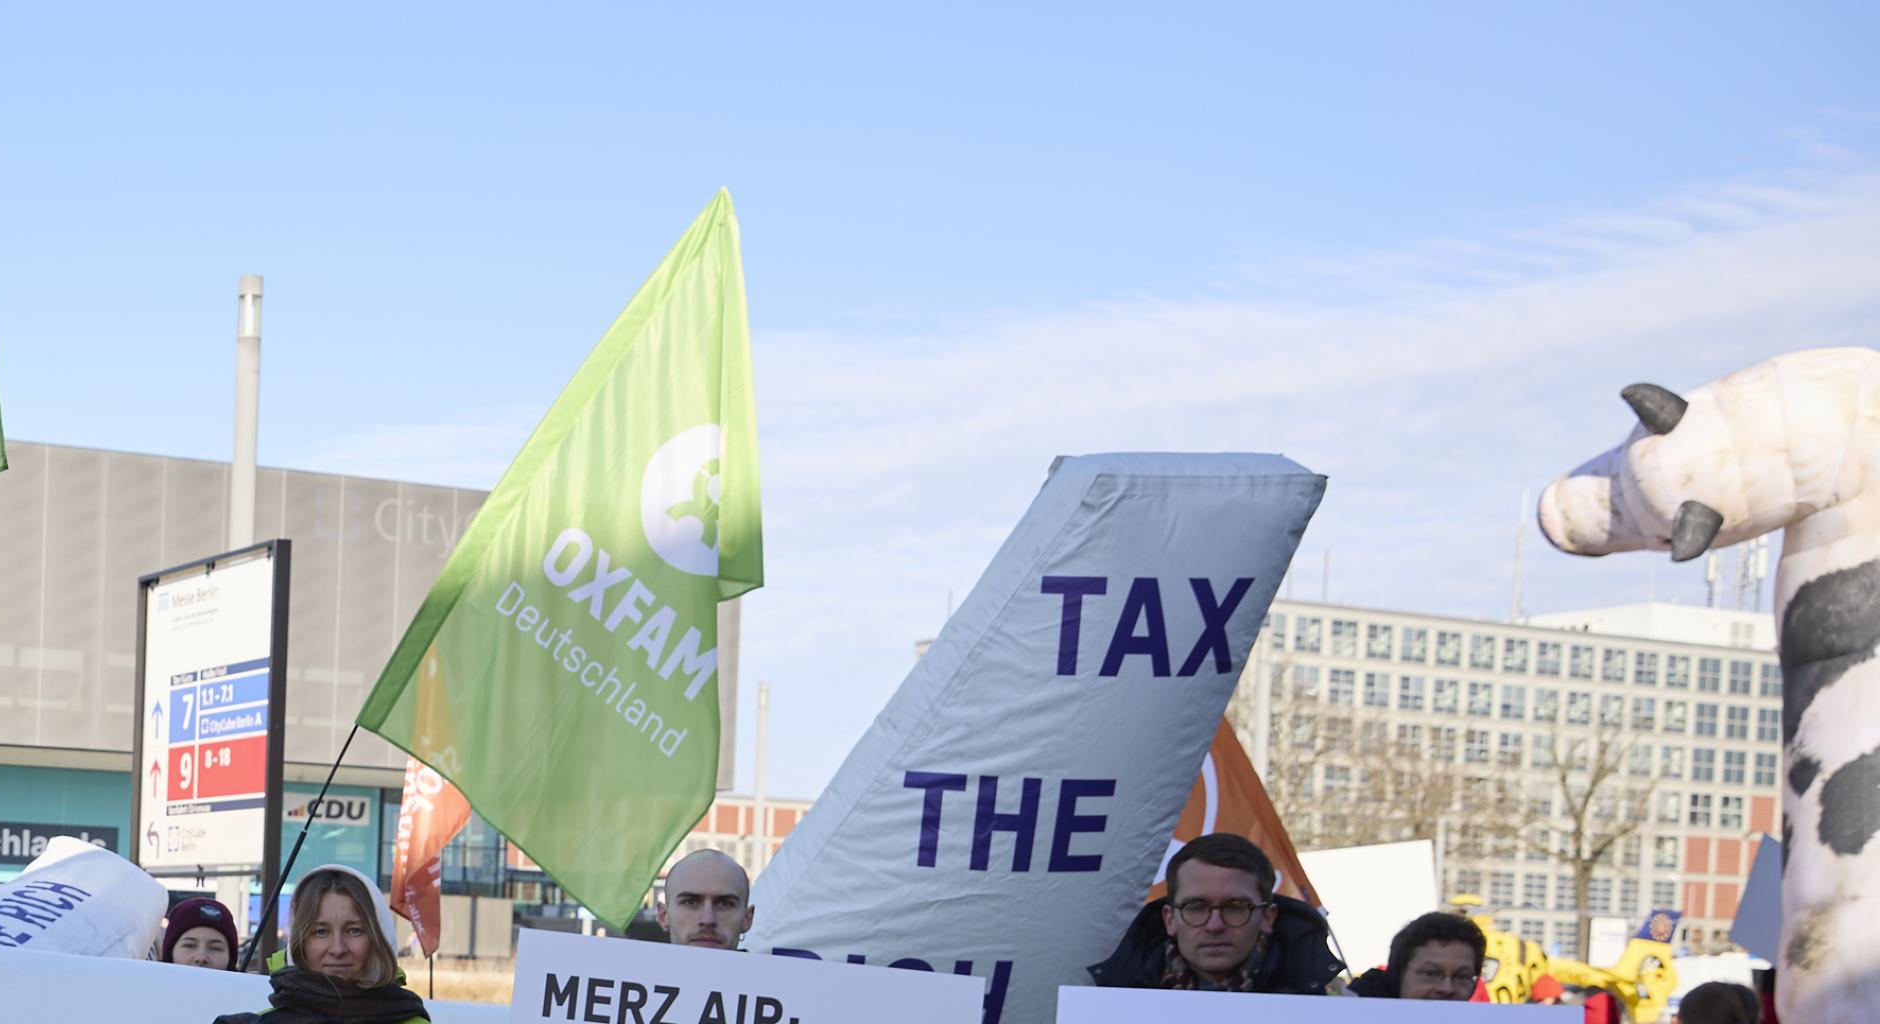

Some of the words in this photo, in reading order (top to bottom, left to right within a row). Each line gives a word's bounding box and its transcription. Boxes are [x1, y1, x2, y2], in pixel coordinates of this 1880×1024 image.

[542, 528, 719, 701] OXFAM
[1040, 575, 1255, 677] TAX
[182, 693, 194, 730] 7
[495, 581, 689, 758] Deutschland
[180, 752, 193, 790] 9
[307, 798, 366, 820] CDU
[903, 770, 1117, 873] THE
